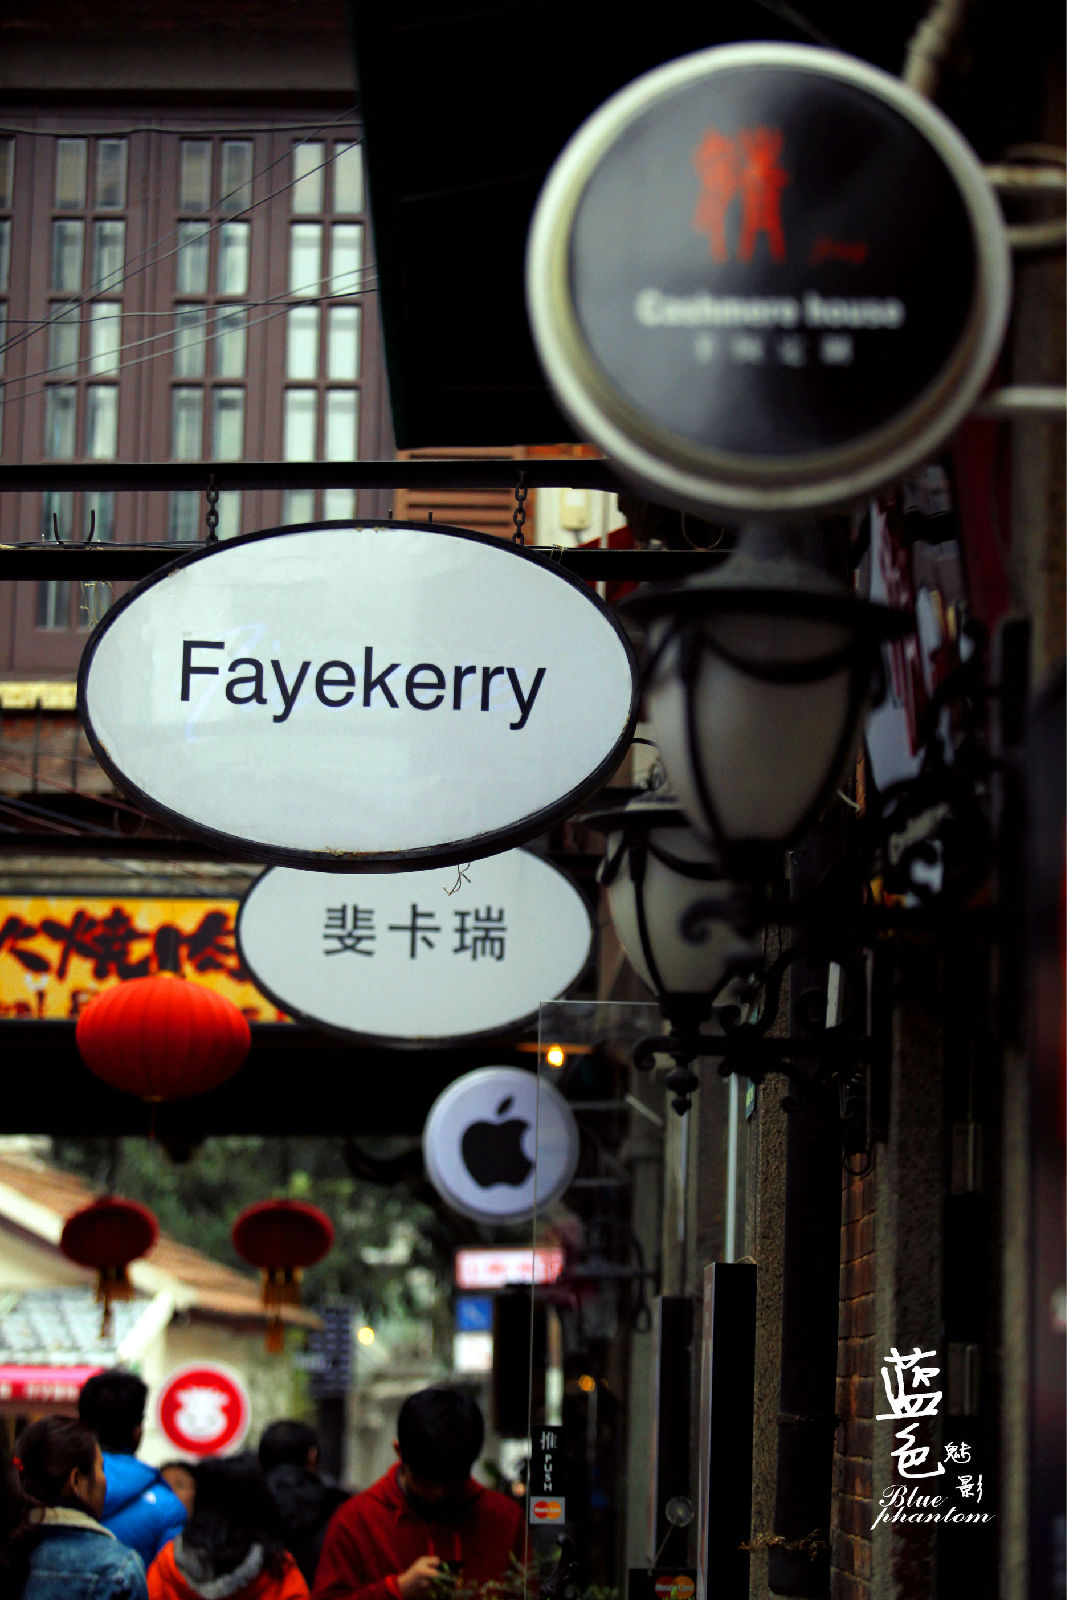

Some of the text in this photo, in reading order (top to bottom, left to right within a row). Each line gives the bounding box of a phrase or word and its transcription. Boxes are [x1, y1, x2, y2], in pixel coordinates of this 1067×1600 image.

[180, 640, 547, 730] Fayekerry
[322, 902, 508, 961] 斐卡瑞
[540, 1431, 557, 1451] 推
[544, 1454, 553, 1491] PUSH
